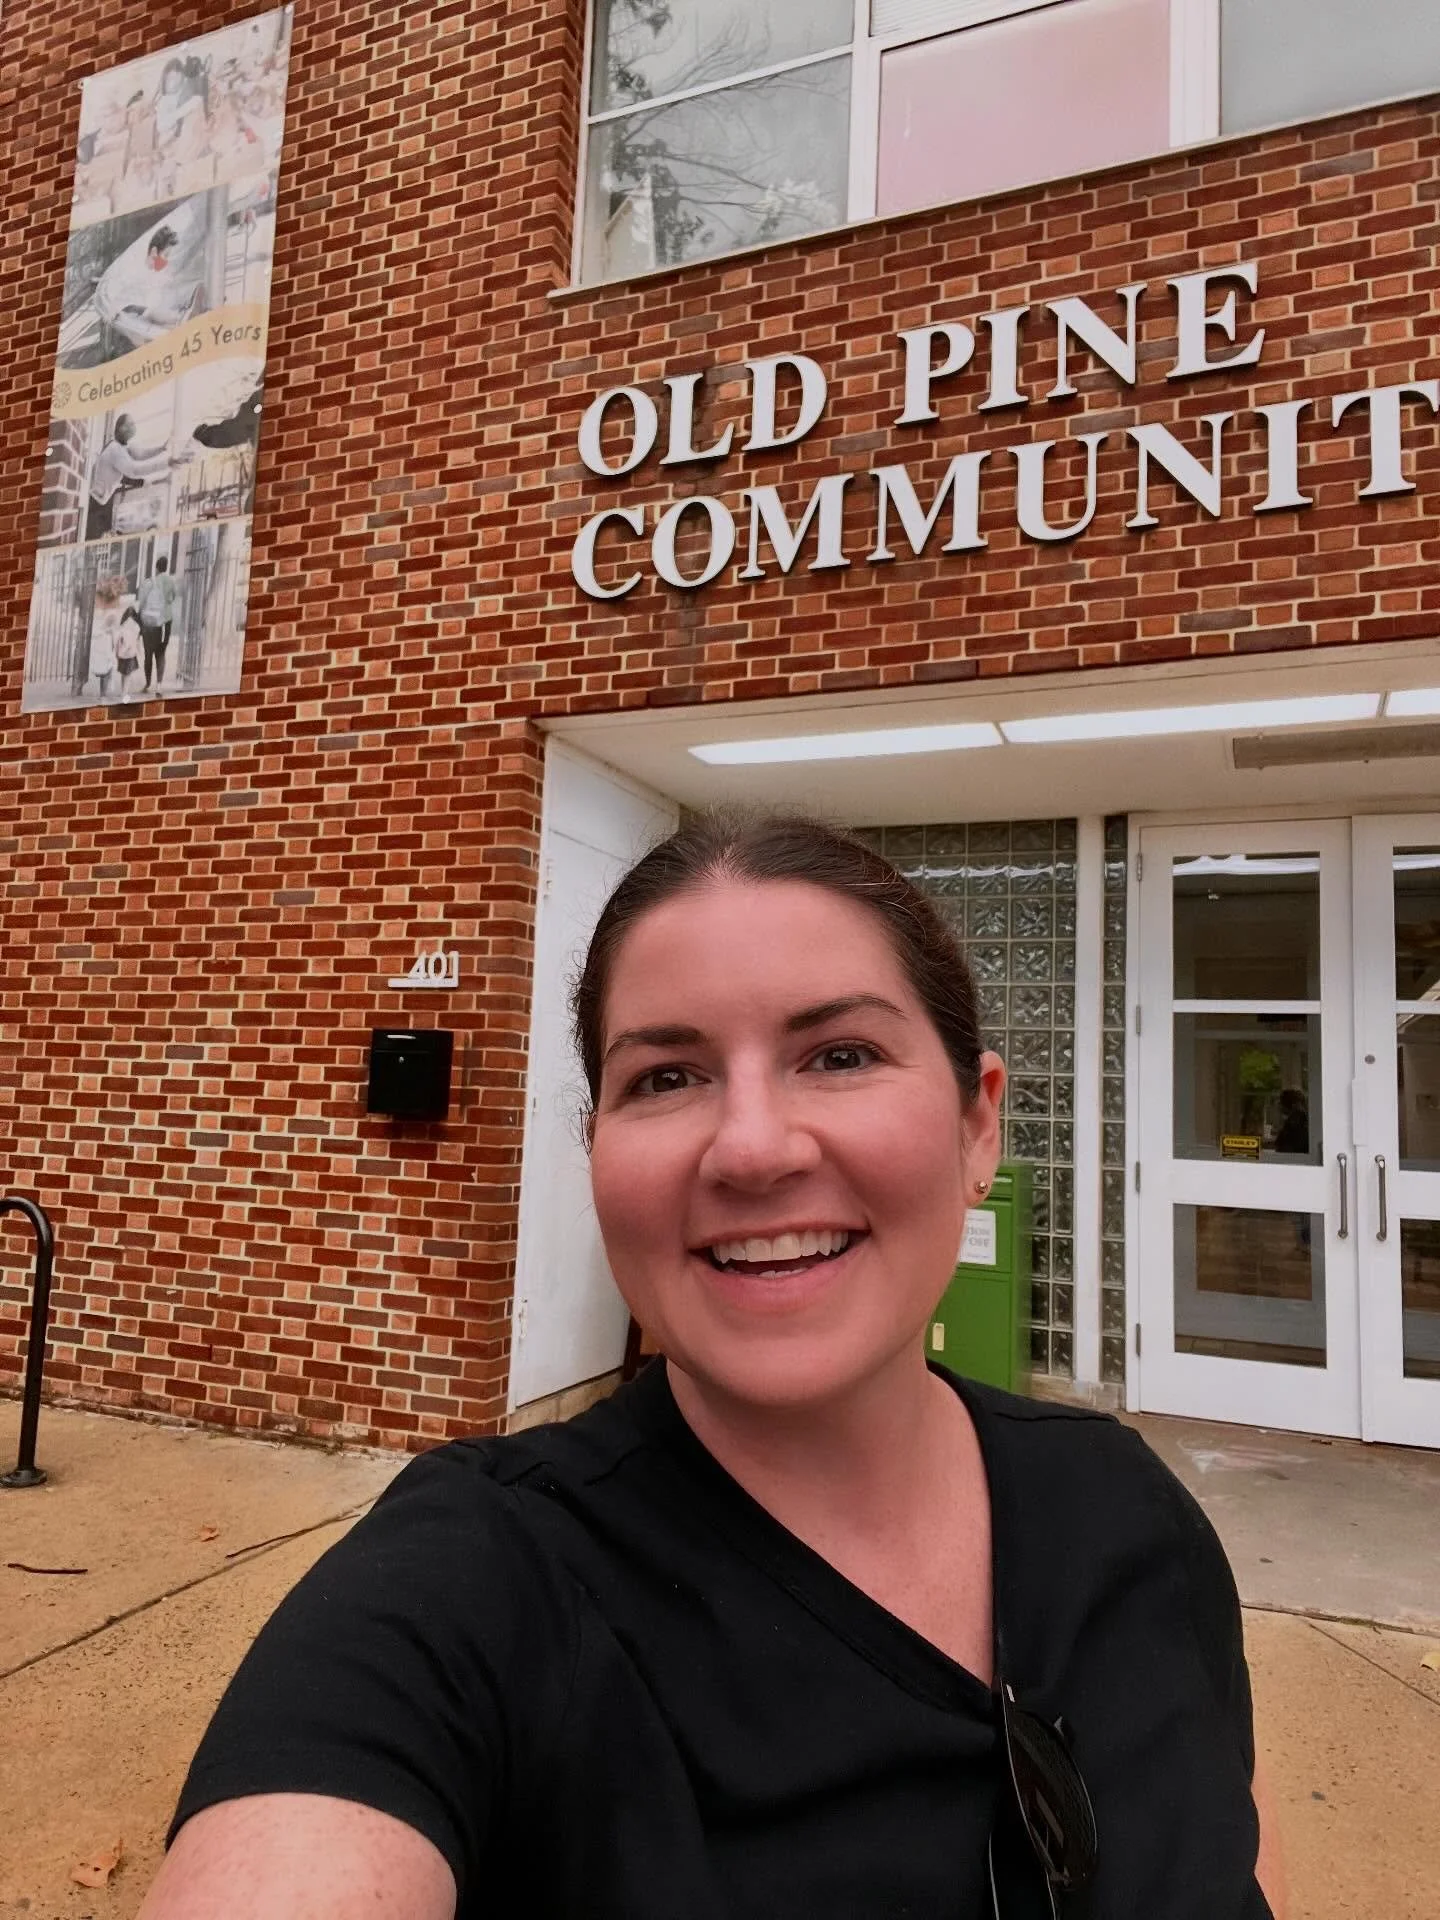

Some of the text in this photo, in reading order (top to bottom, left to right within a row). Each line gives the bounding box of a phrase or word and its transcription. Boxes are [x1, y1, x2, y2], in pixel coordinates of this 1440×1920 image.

[77, 323, 262, 403] Celebrating 45 Years
[578, 263, 1266, 477] OLD PINE
[571, 380, 1440, 600] COMMUNIT
[407, 950, 459, 981] 401
